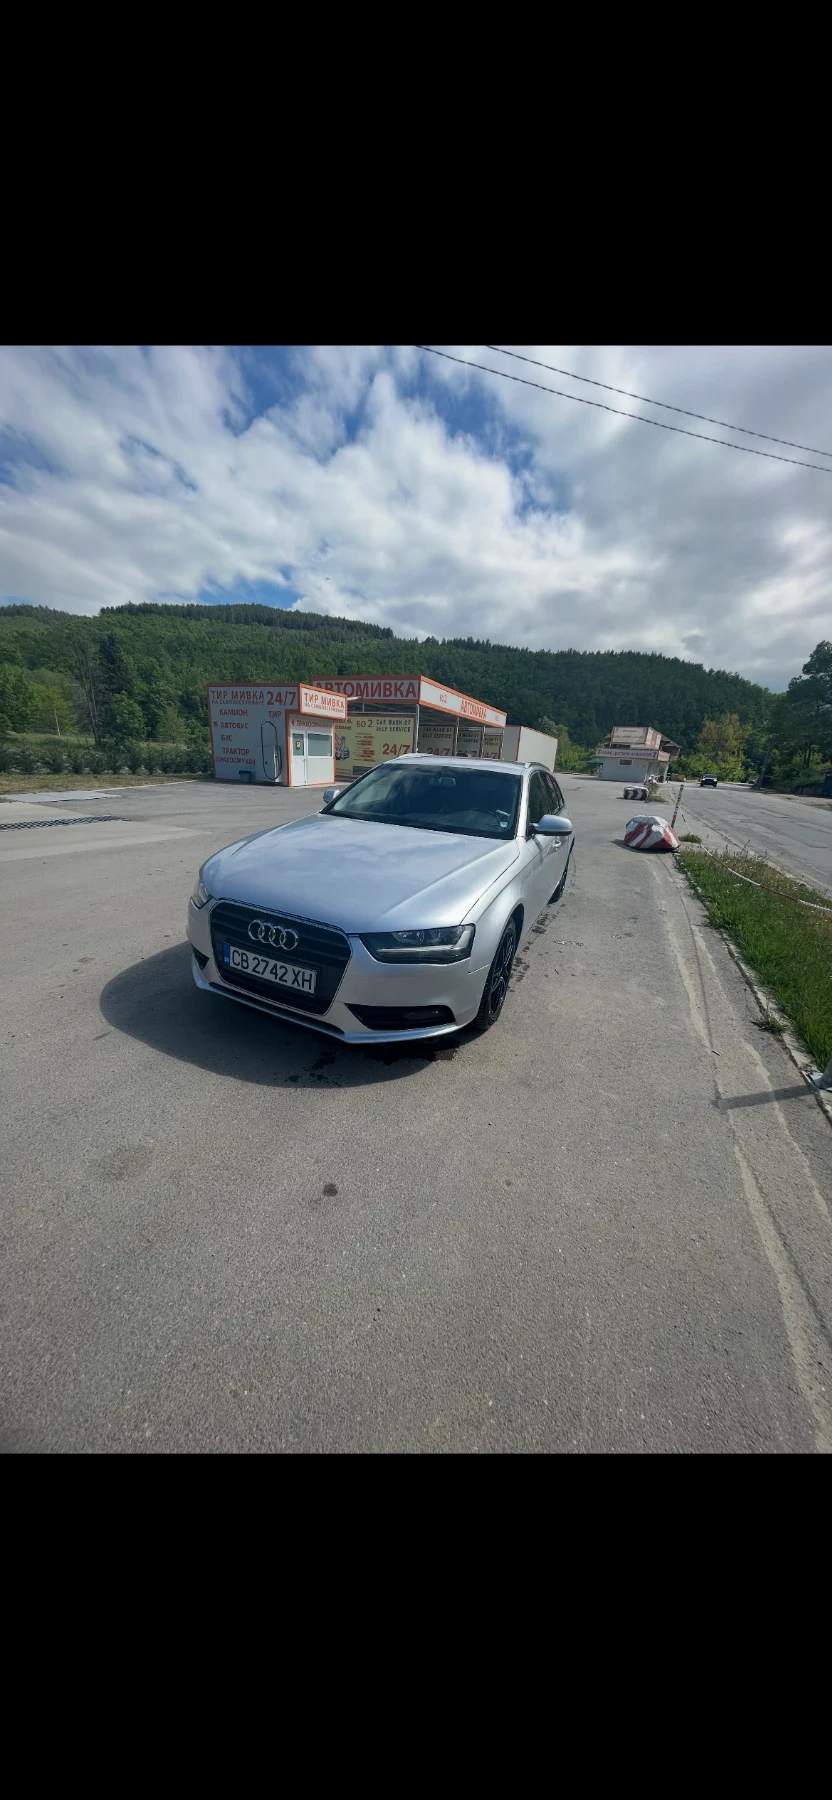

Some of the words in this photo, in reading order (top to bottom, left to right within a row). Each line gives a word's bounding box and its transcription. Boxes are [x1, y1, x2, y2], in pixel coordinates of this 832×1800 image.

[211, 690, 228, 700] ТИР
[231, 690, 265, 700] МИВКА
[266, 691, 296, 706] 24/7
[304, 692, 318, 704] ТИР
[320, 696, 344, 708] МИВКА
[220, 708, 248, 716] КАМИОН
[461, 699, 487, 720] АВТОМИВКА
[368, 720, 373, 728] 2
[382, 743, 410, 756] 24/7
[427, 748, 450, 756] 24/7
[232, 950, 249, 969] CB
[252, 957, 288, 983] 2742
[292, 968, 312, 990] XH
